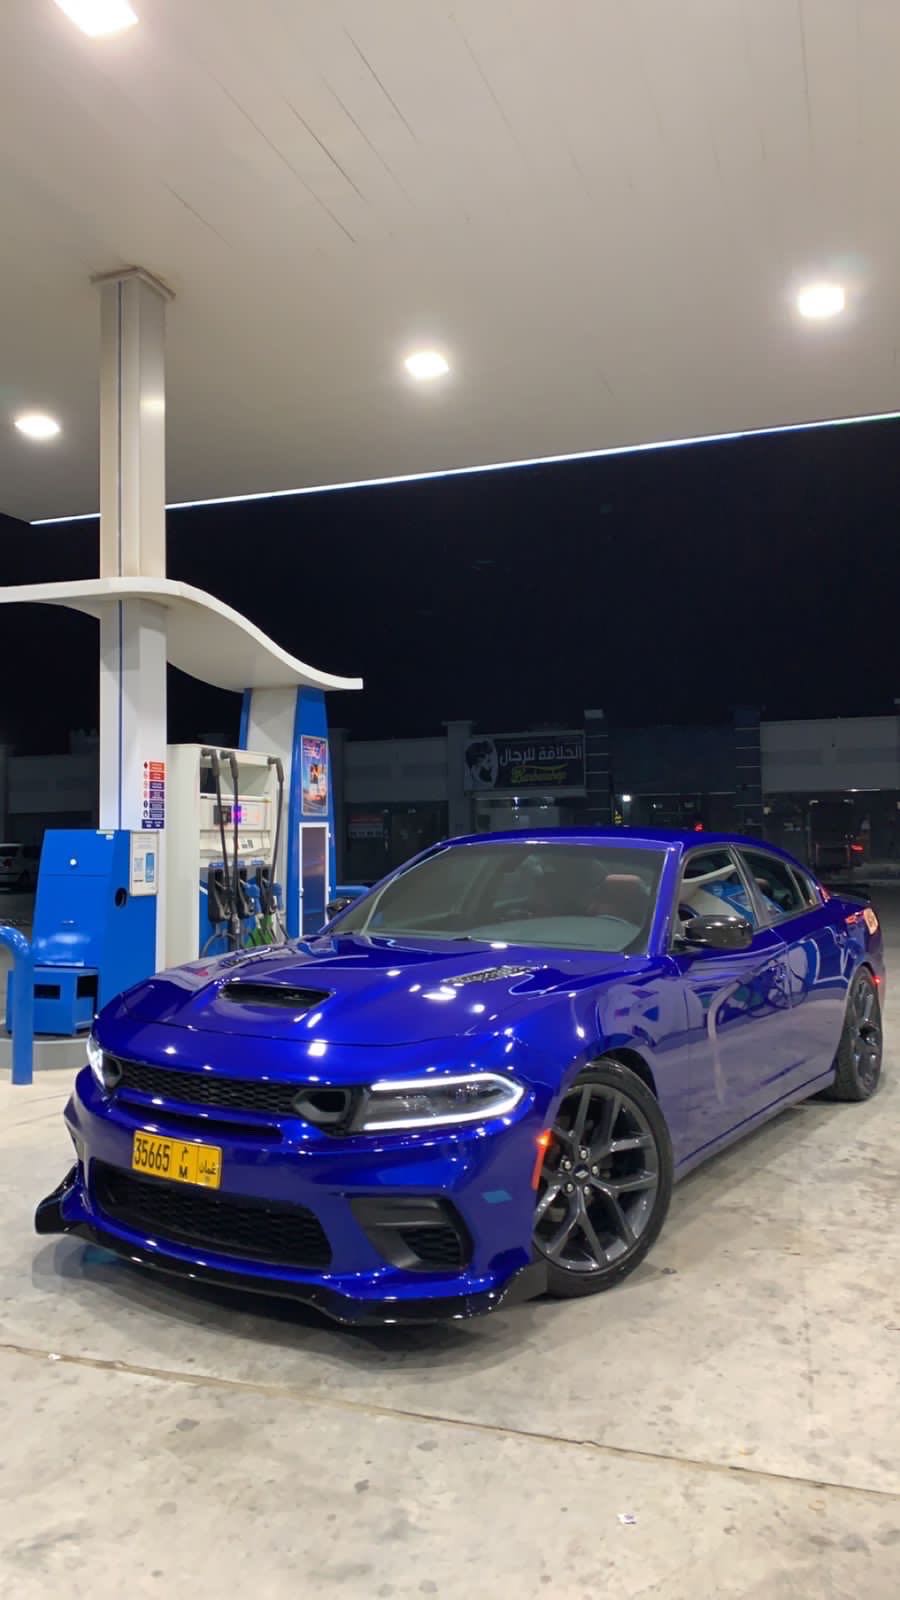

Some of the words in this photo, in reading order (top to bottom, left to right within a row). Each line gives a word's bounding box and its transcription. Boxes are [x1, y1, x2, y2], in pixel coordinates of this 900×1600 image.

[499, 747, 535, 766] للرجال
[538, 744, 582, 760] الحلاقة
[134, 1137, 170, 1172] 35665
[179, 1166, 188, 1178] M
